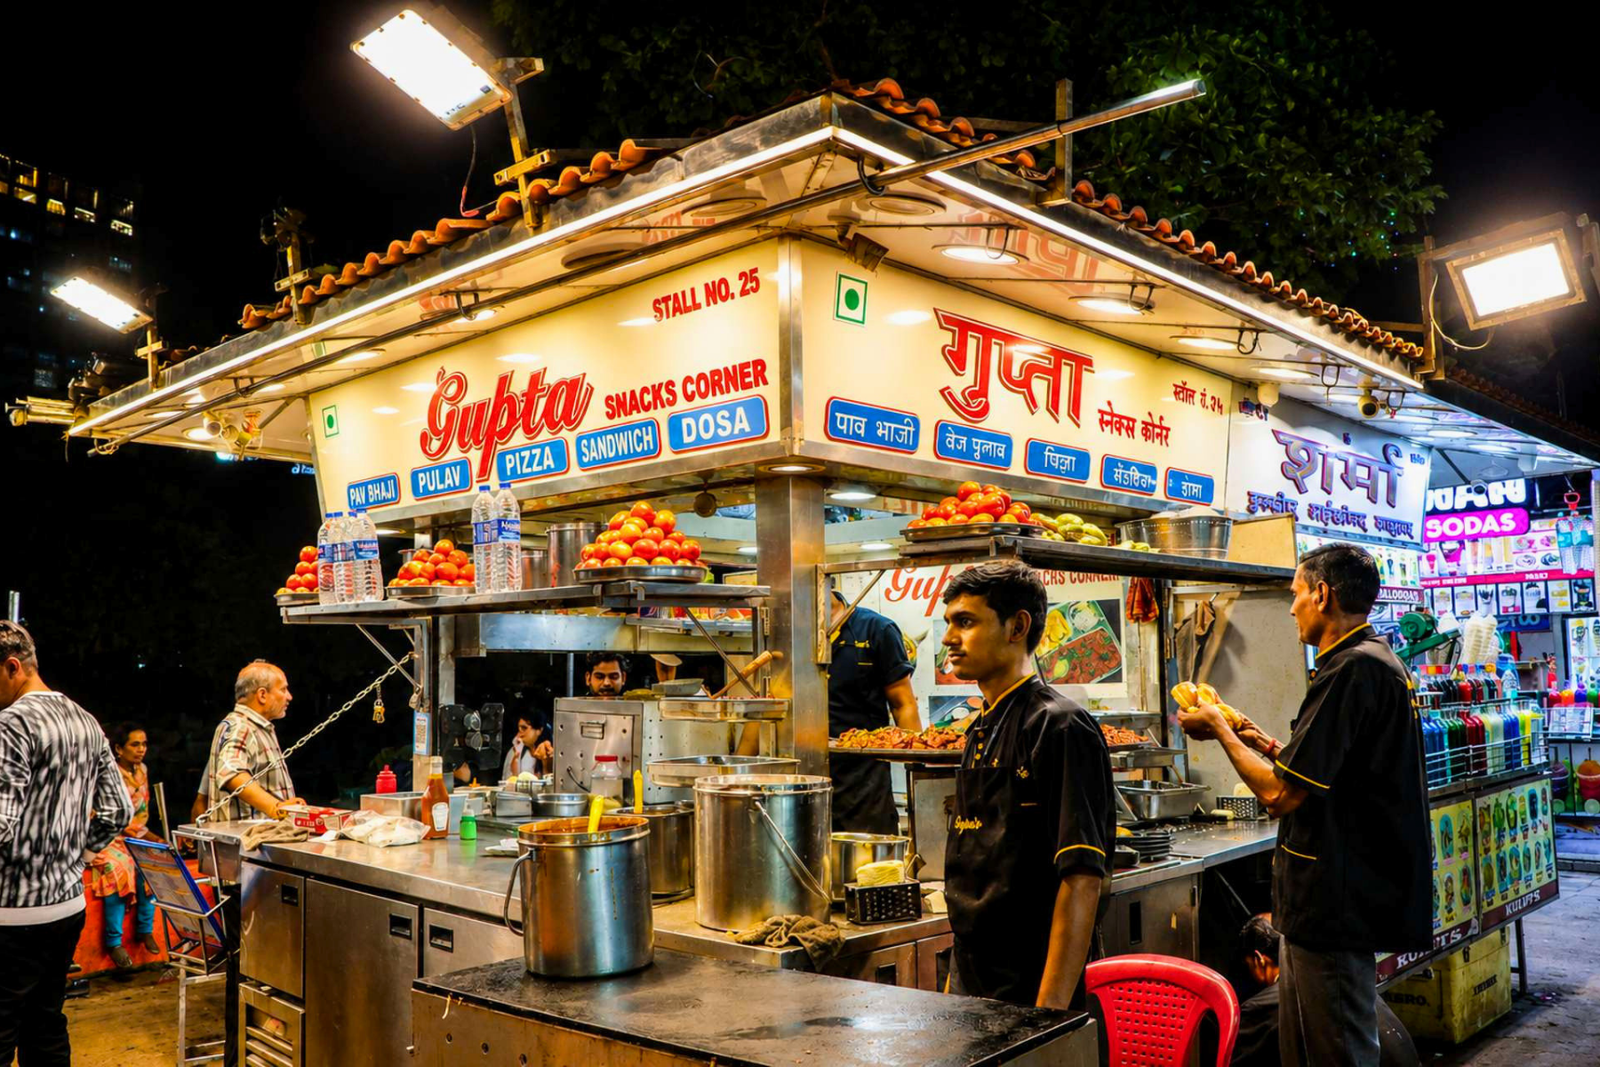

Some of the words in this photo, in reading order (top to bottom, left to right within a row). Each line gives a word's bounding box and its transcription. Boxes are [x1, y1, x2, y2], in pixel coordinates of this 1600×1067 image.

[652, 287, 702, 322] STALL
[704, 277, 735, 307] NO.
[738, 267, 760, 297] 25
[933, 307, 1095, 428] गुप्ता
[604, 379, 678, 420] SNACKS
[682, 358, 769, 402] CORNER
[420, 366, 595, 483] Gupta
[681, 406, 751, 444] DOSA
[835, 412, 867, 438] पाव
[875, 418, 915, 446] भाजी
[505, 446, 555, 476] PIZZA
[580, 425, 655, 463] SANDWICH
[349, 486, 366, 506] PAV
[367, 479, 395, 503] BHAJI
[418, 465, 460, 493] PULAV
[1425, 512, 1517, 538] SODAS
